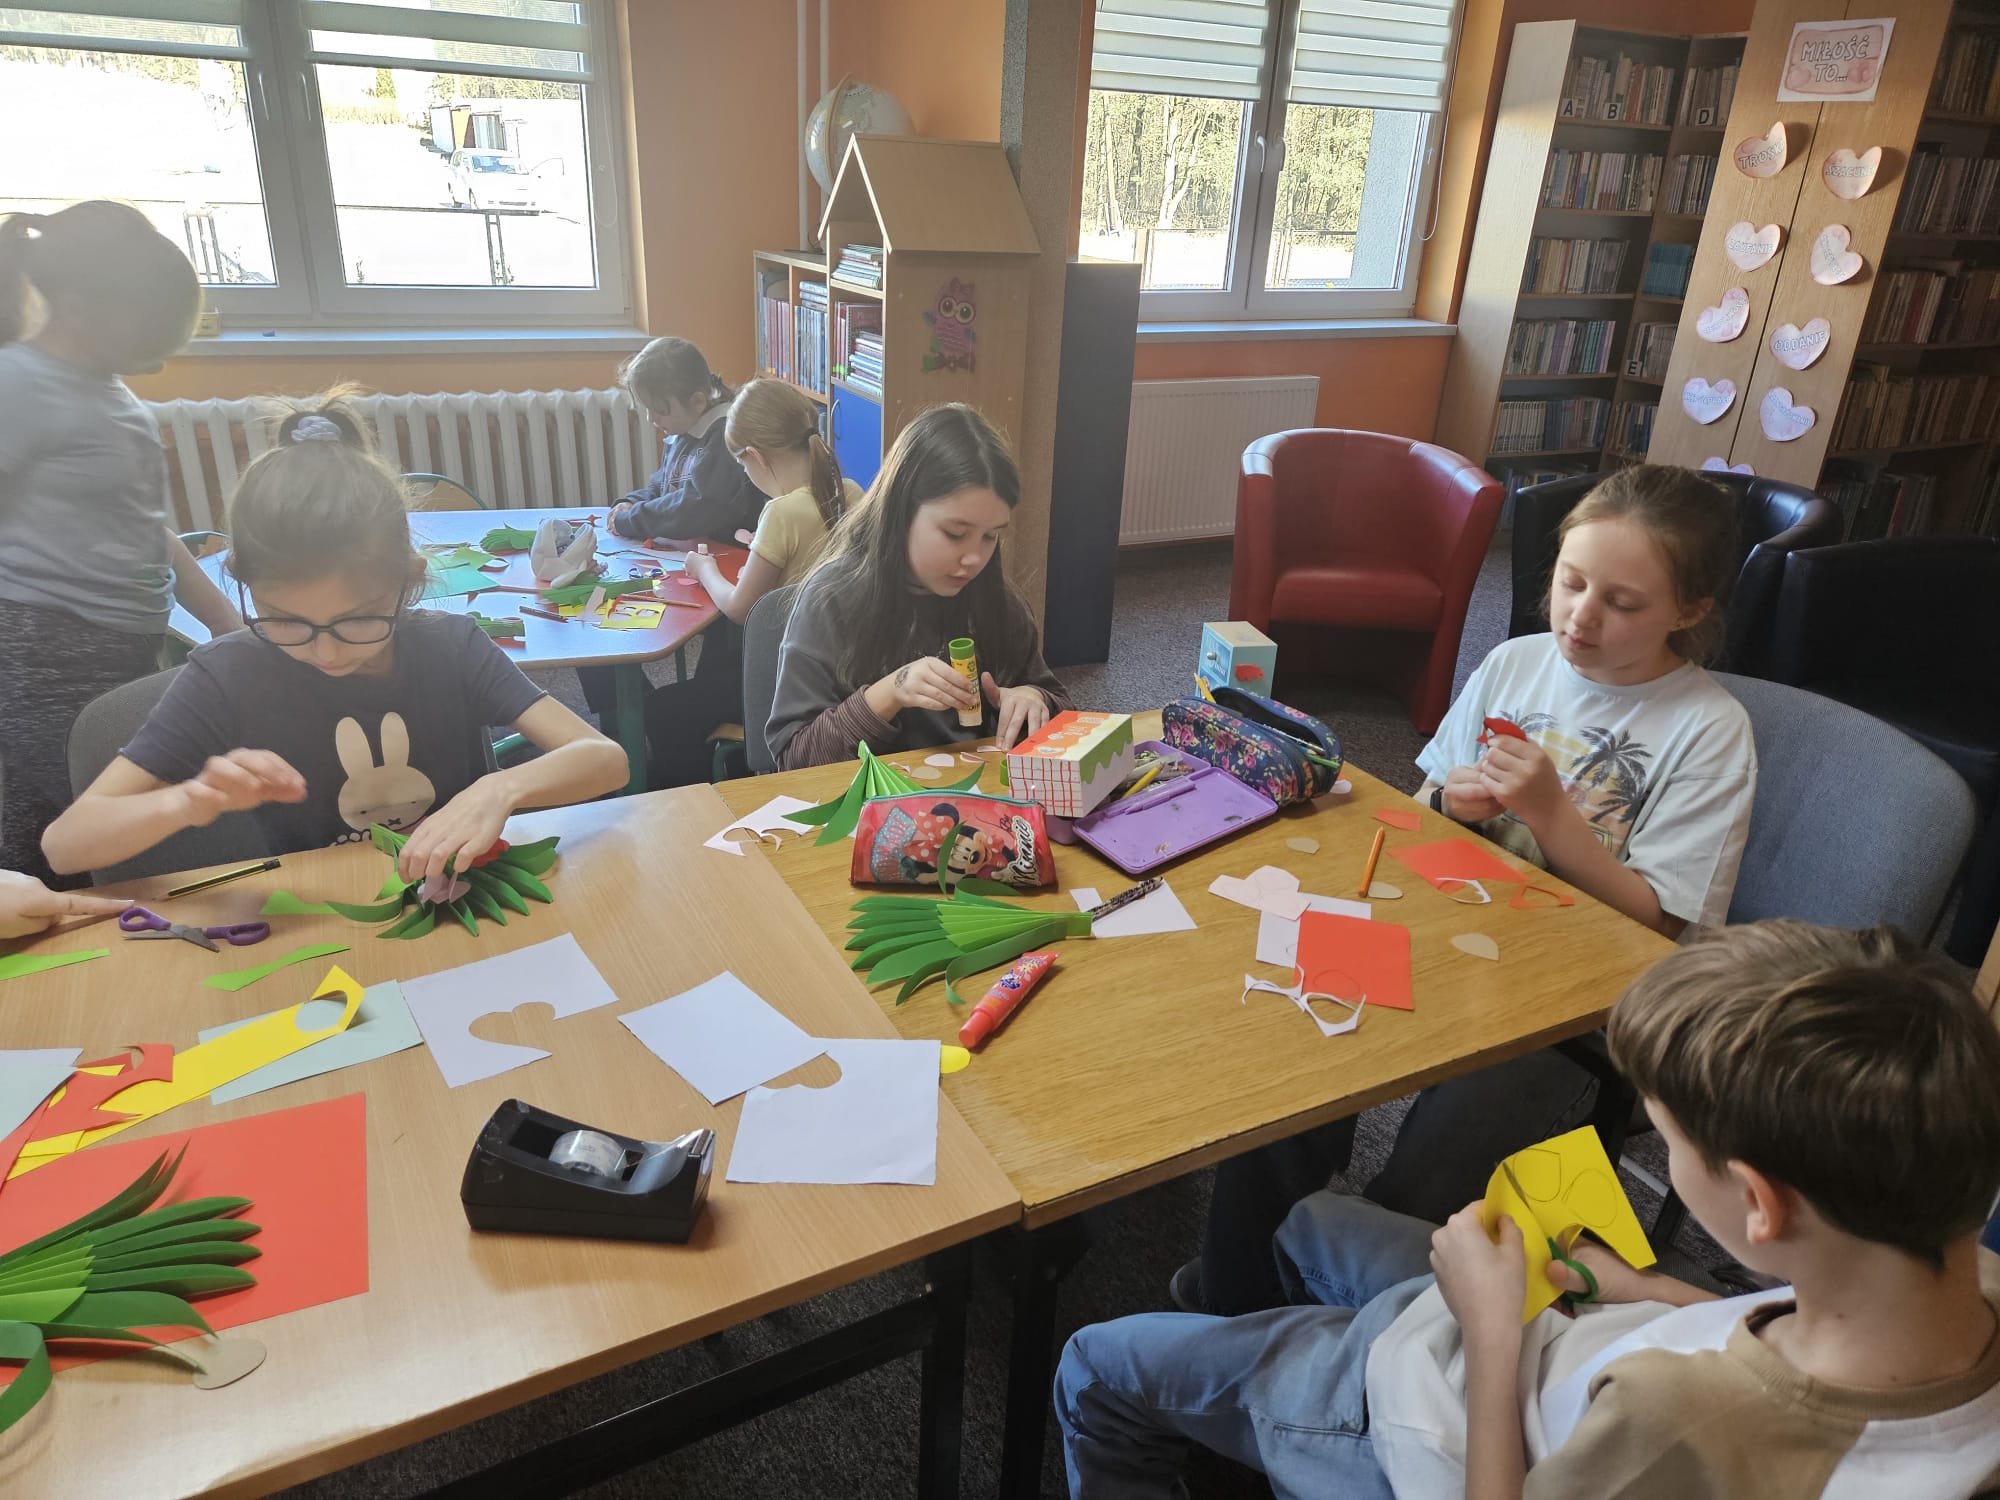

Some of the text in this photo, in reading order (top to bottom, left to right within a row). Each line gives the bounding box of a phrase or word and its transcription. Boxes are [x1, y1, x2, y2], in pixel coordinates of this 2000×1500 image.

[1801, 35, 1870, 62] MIŁOŚĆ
[1815, 63, 1848, 83] TO...
[1563, 100, 1574, 116] A
[1607, 104, 1618, 119] B
[1699, 109, 1711, 125] D
[1627, 360, 1638, 376] E
[1011, 817, 1038, 884] Minnie
